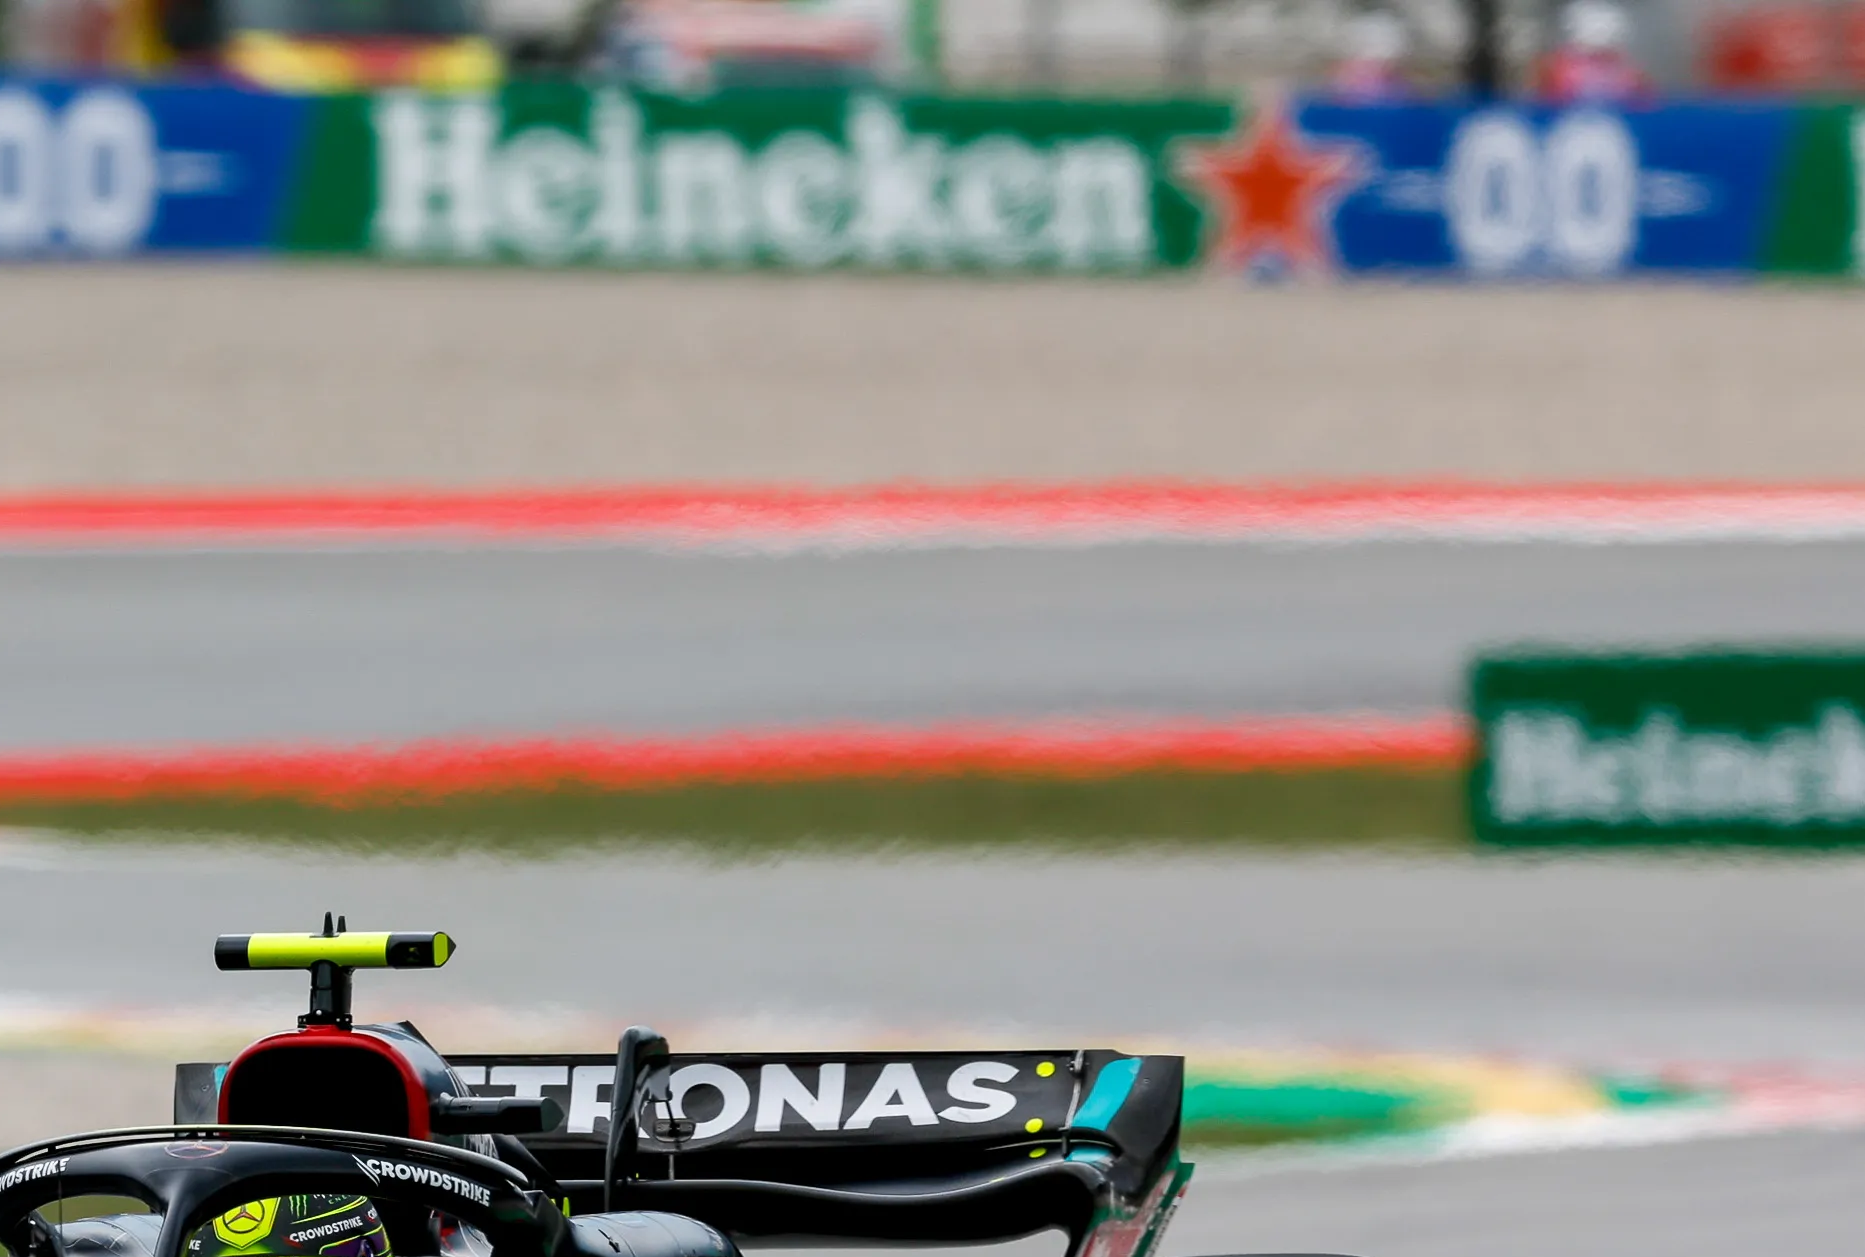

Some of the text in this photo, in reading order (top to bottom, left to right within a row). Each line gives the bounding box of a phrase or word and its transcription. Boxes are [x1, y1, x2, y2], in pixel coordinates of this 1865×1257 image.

[376, 92, 1152, 264] Heineken
[366, 1159, 491, 1207] CROWDSTRIKE
[289, 1216, 363, 1243] CROWDSTRIKE
